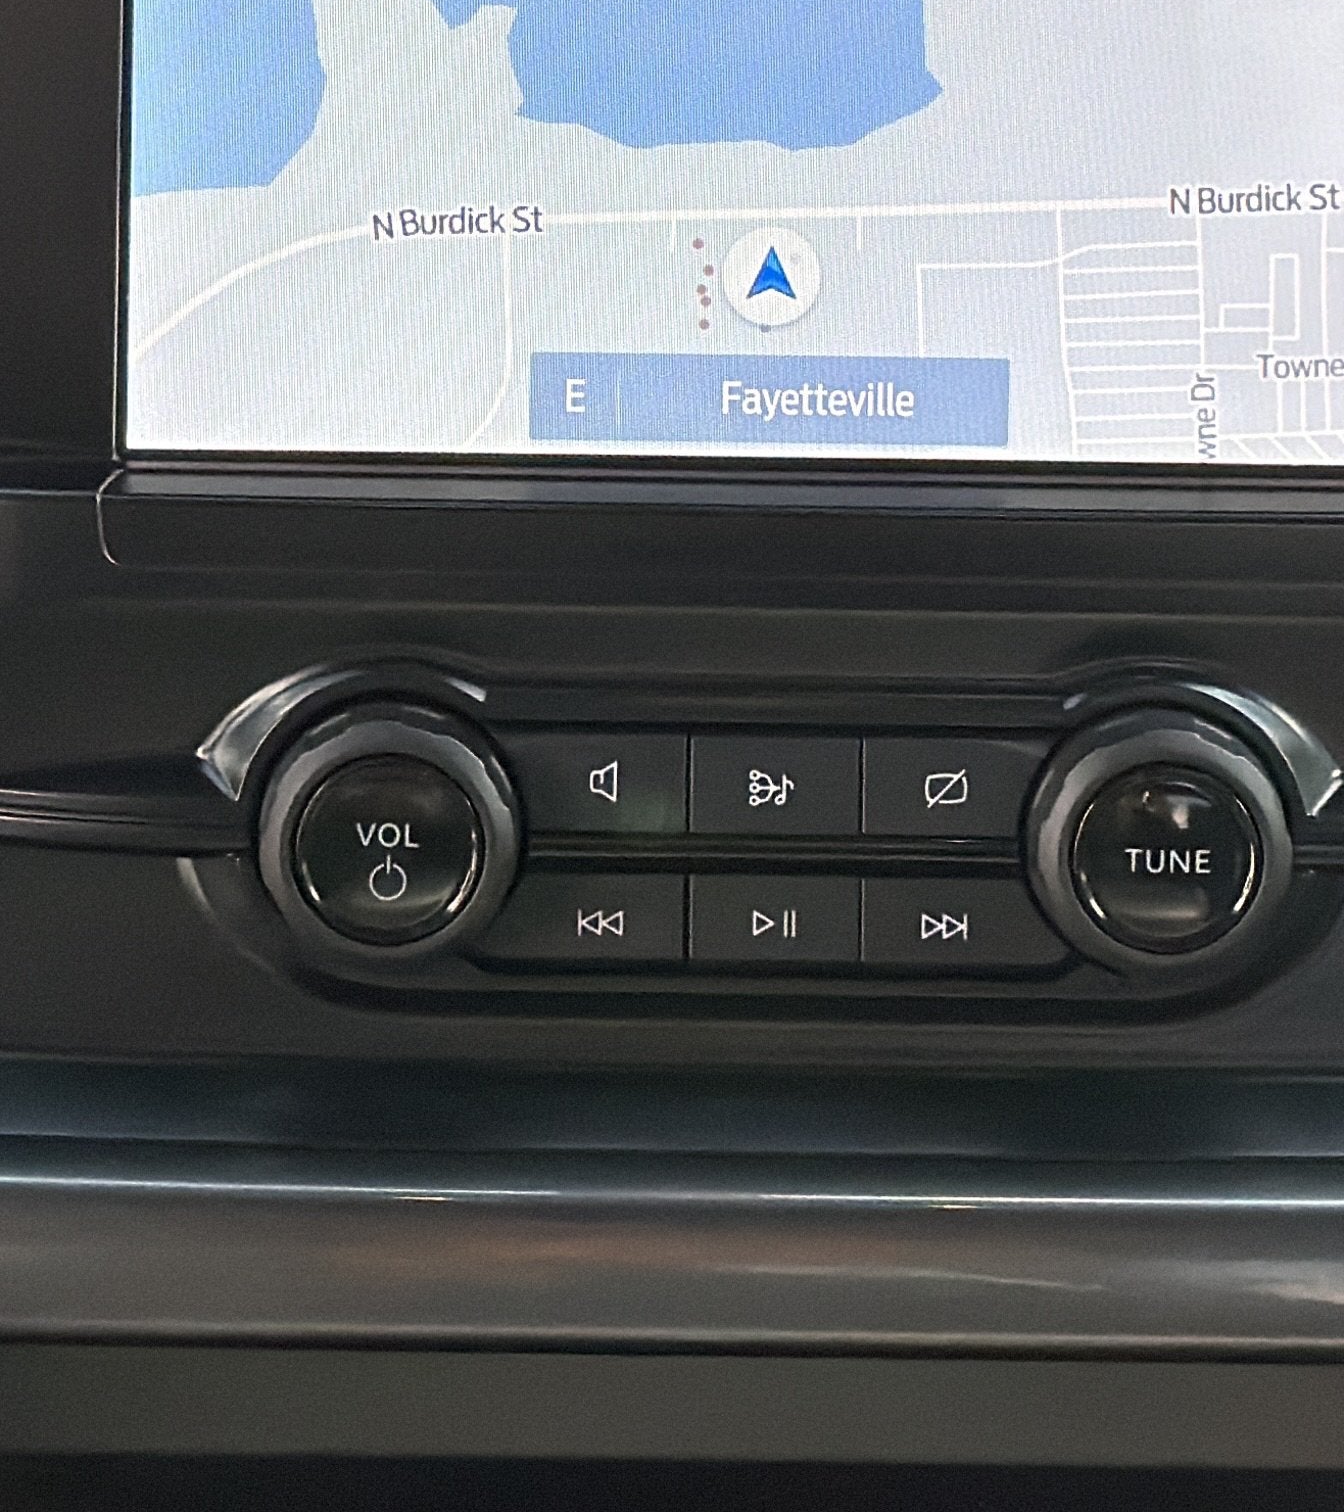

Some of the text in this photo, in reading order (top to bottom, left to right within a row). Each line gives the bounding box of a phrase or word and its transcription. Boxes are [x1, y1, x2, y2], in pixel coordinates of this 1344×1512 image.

[1169, 182, 1342, 215] N Burdick St
[372, 204, 544, 241] N Burdick St
[564, 378, 587, 414] E
[720, 379, 916, 422] Fayetteville
[1190, 371, 1216, 401] Dr
[355, 821, 420, 848] VOL
[1124, 848, 1211, 874] TUNE
